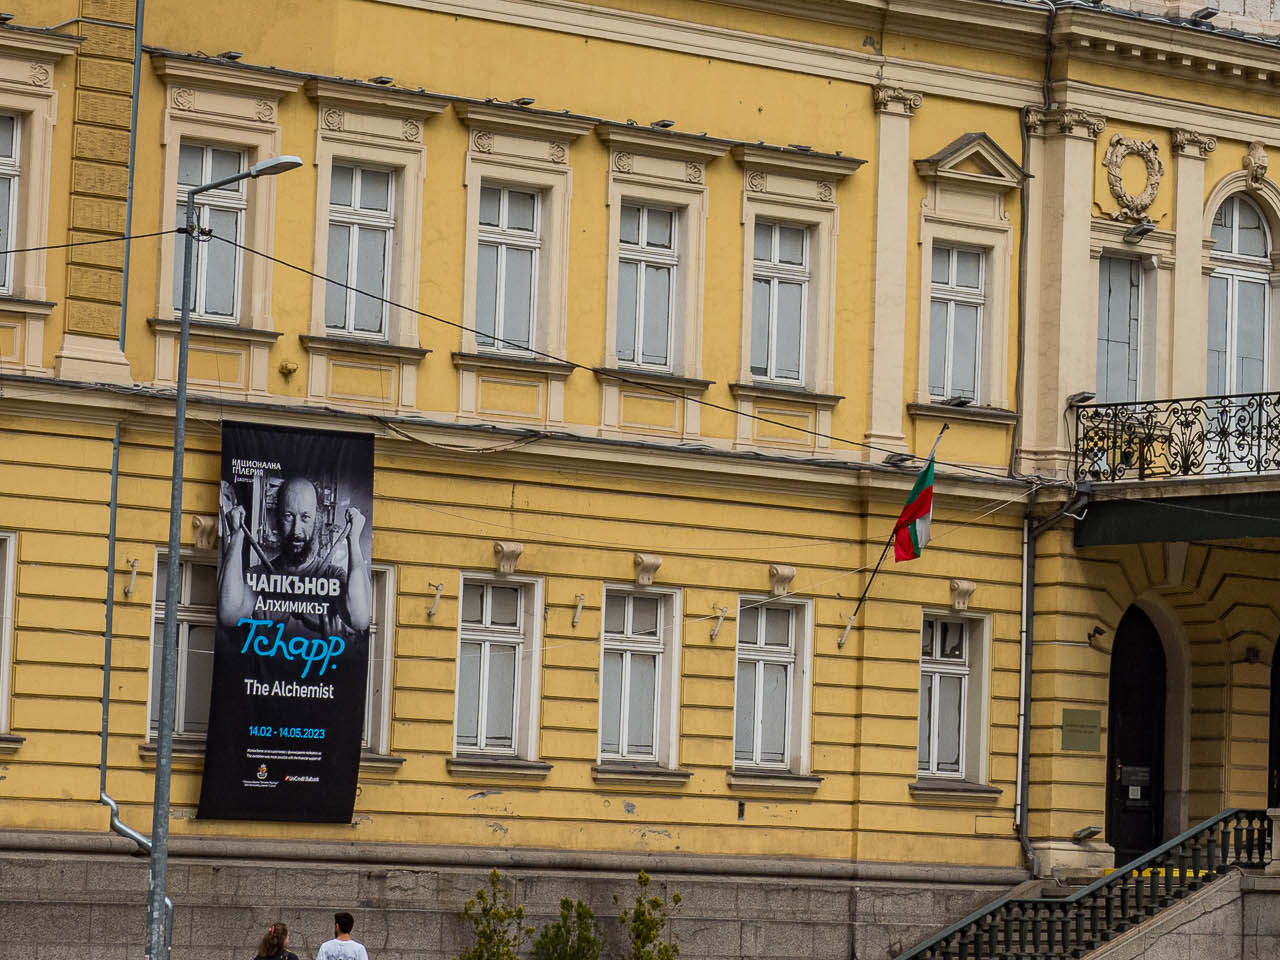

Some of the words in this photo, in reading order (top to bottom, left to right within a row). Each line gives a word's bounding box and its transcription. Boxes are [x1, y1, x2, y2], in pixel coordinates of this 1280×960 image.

[232, 458, 282, 471] НАЦИОНАЛНА
[232, 466, 264, 477] ГАЛЕРИЯ
[246, 573, 341, 596] ЧАПКЪНОВ
[244, 678, 273, 696] The
[271, 681, 335, 700] Alchemist
[249, 725, 273, 737] 14.02
[279, 727, 326, 740] 14.05.2023
